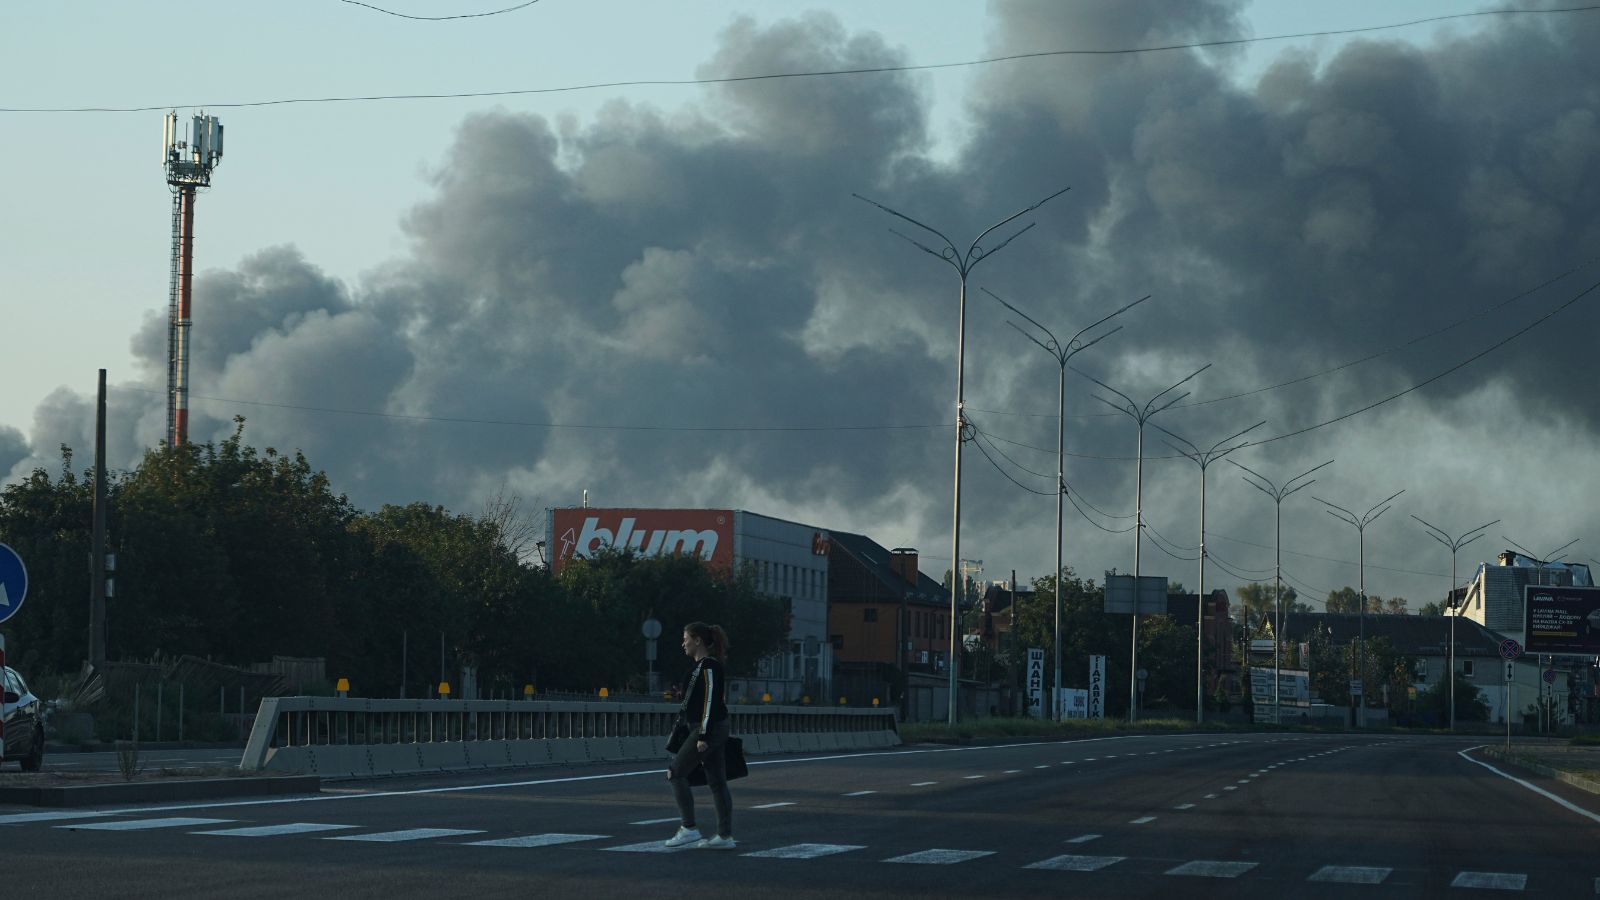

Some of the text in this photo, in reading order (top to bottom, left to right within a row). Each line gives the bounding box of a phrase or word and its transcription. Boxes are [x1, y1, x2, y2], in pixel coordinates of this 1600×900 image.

[573, 517, 719, 561] blum
[1029, 651, 1042, 707] ШЛАНГИ
[1092, 656, 1101, 720] ГІДРАВЛІК
